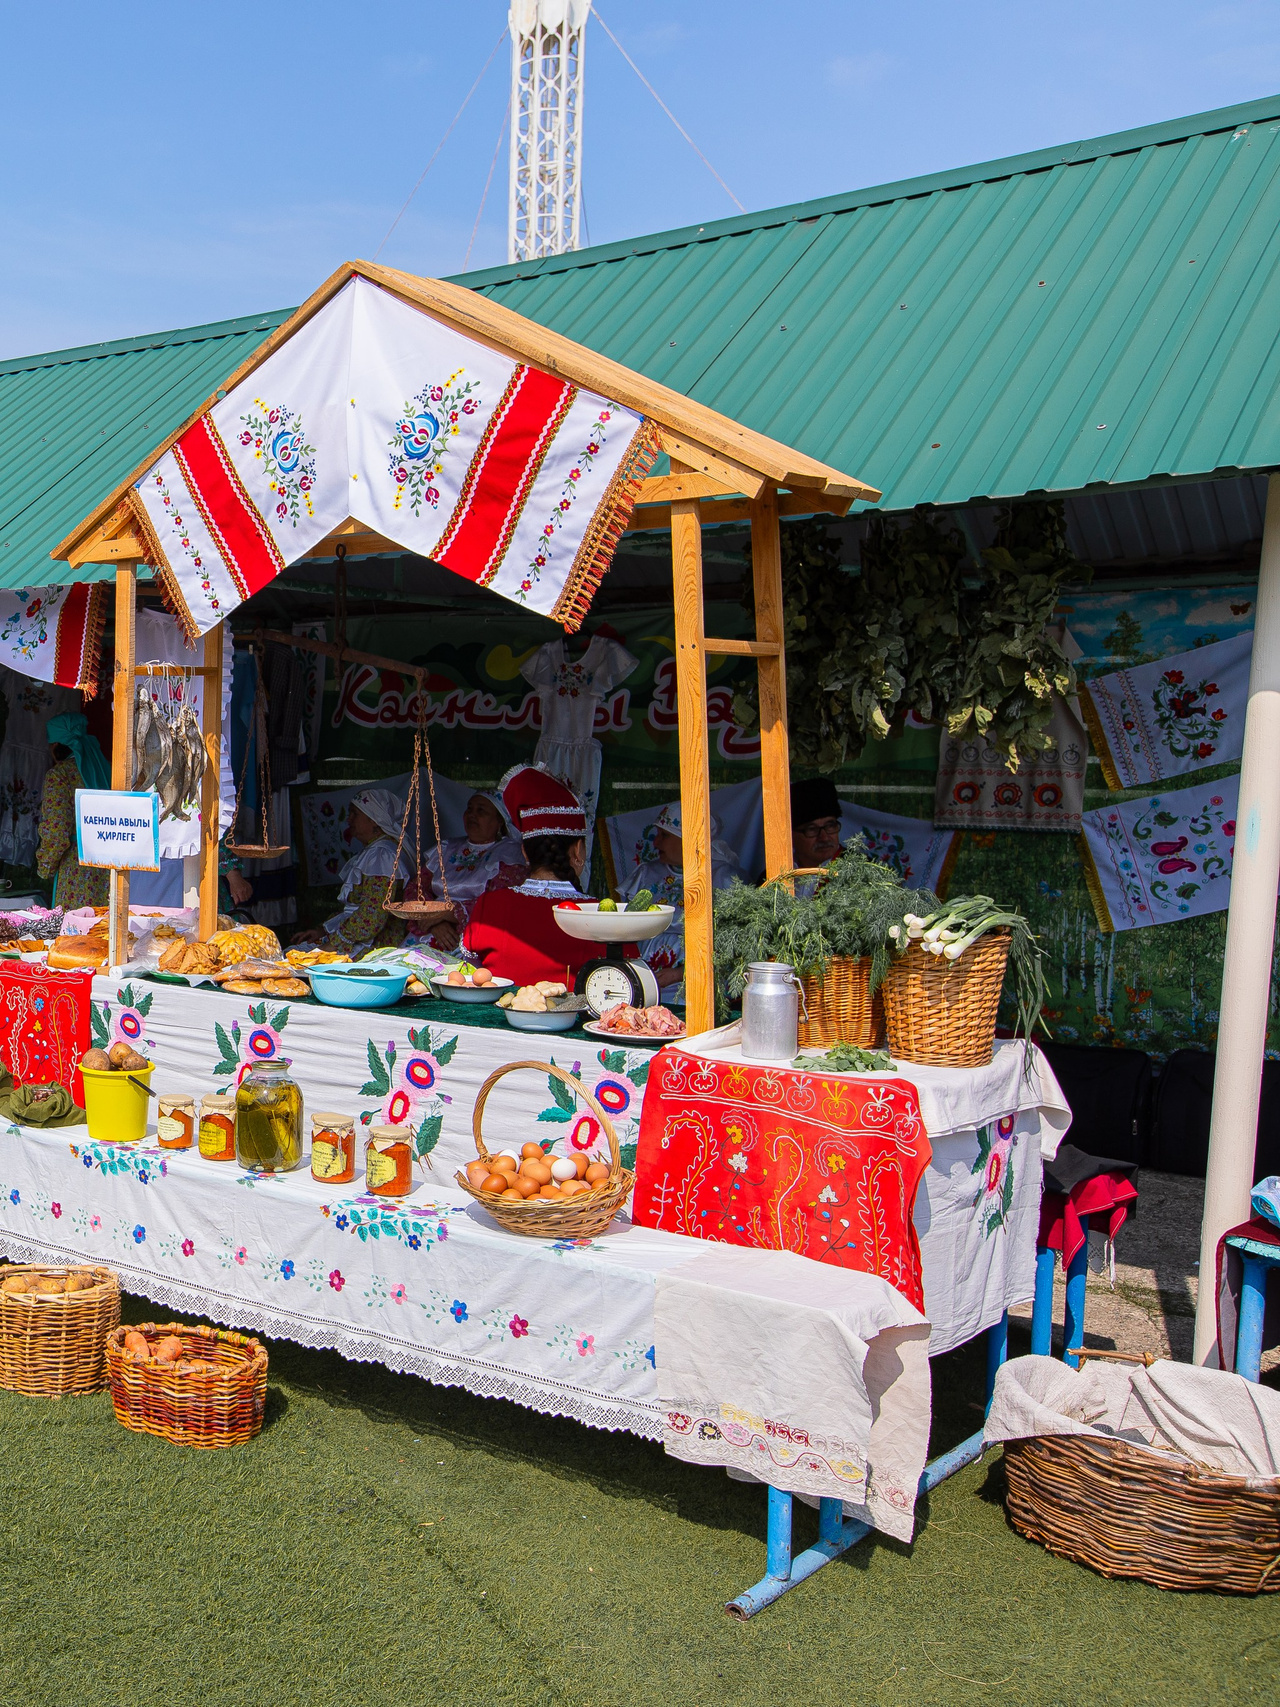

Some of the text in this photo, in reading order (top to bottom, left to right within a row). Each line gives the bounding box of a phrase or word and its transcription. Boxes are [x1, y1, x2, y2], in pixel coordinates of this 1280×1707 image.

[84, 816, 150, 827] КАЕНЛЫ АВЫЛЫ
[97, 831, 135, 842] ҖИРЛЕГЕ
